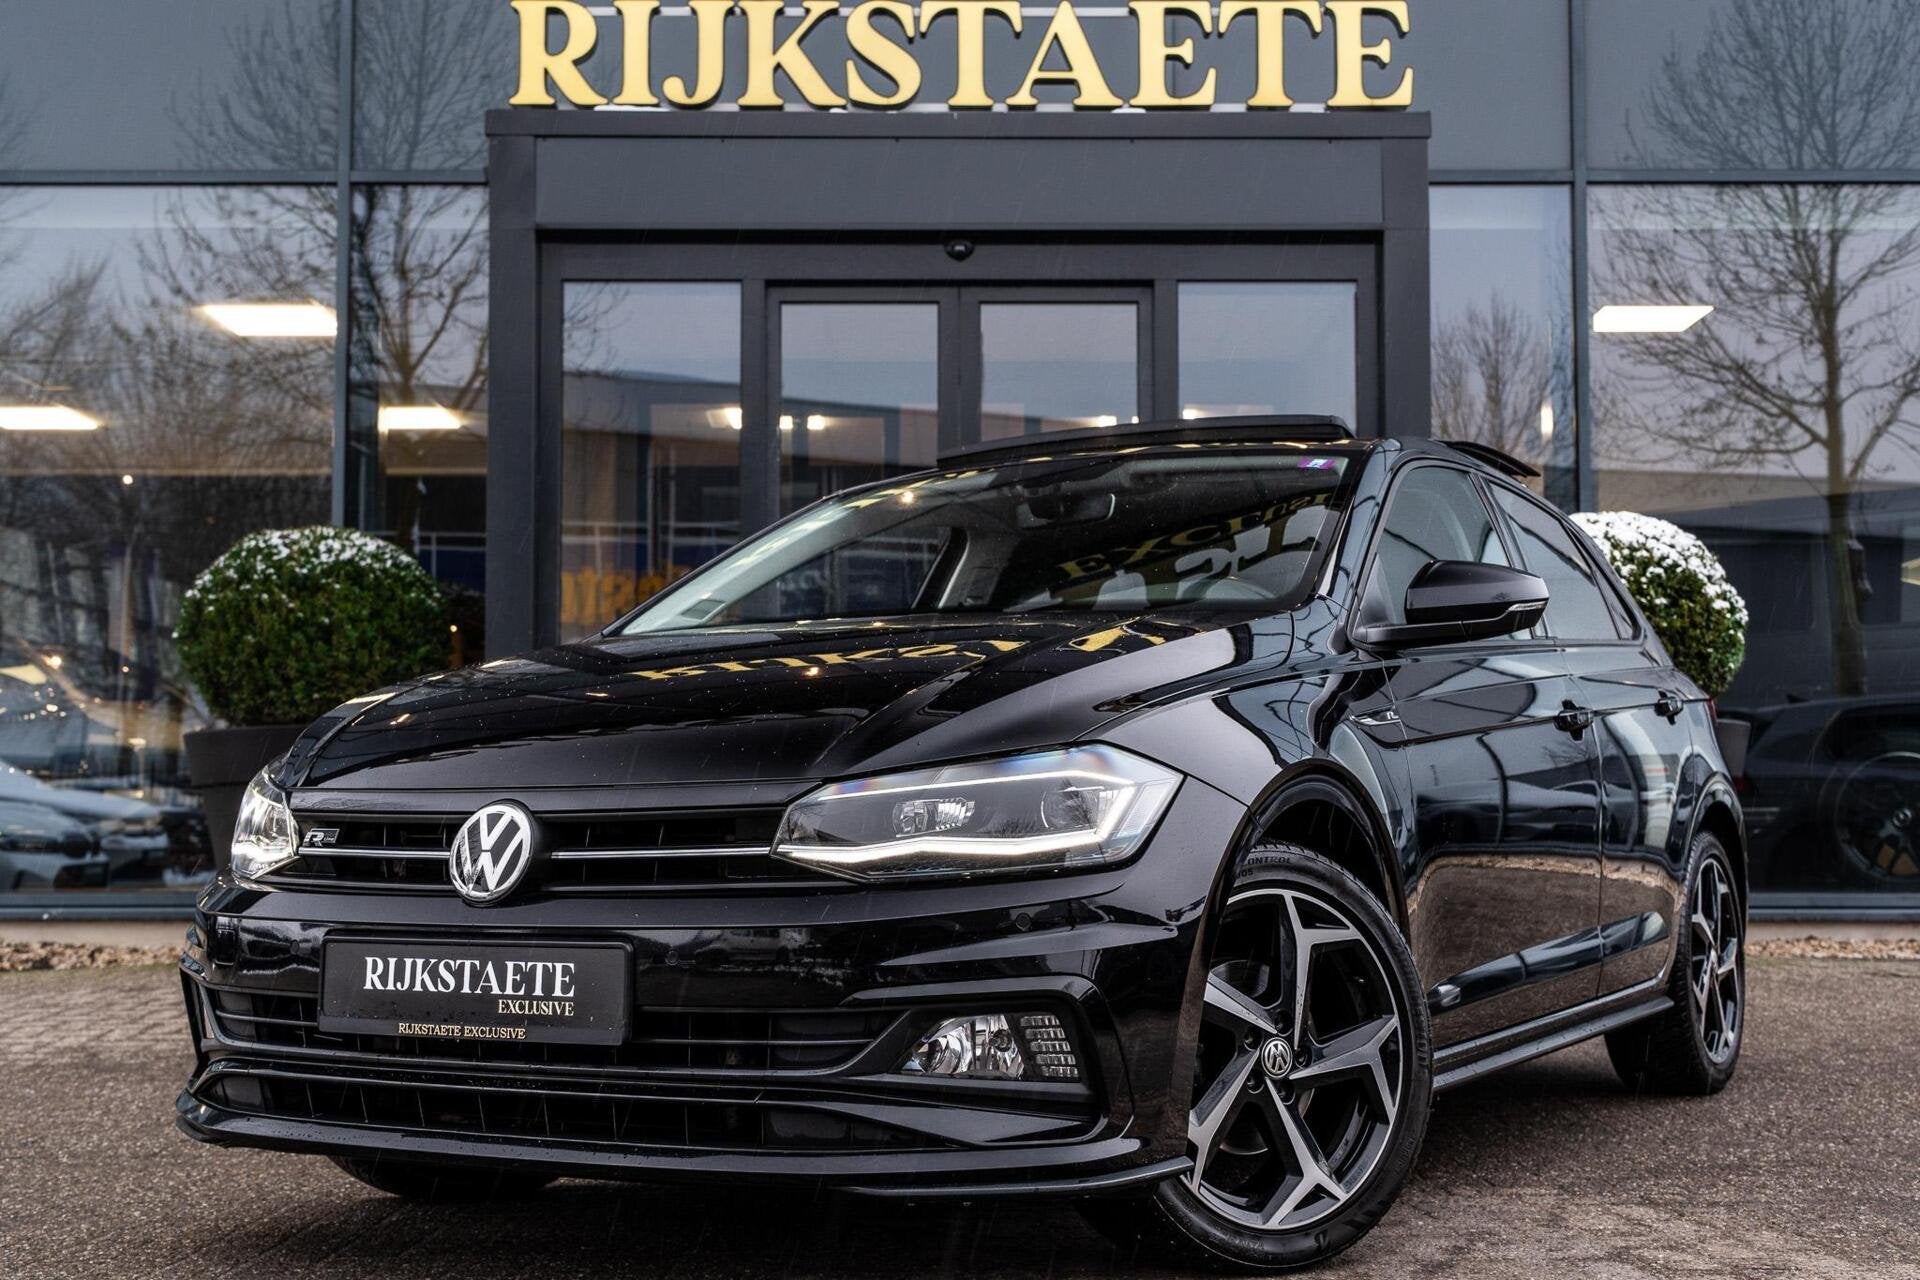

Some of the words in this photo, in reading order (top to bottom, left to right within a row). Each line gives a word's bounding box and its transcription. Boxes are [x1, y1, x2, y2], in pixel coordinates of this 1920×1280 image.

[509, 0, 1415, 109] RIJKSTAETE
[363, 956, 575, 997] RIJKSTAETE
[498, 999, 575, 1017] EXCLUSIVE
[398, 1023, 462, 1038] RIJKSTAETE
[463, 1025, 526, 1040] EXCLUSIVE
